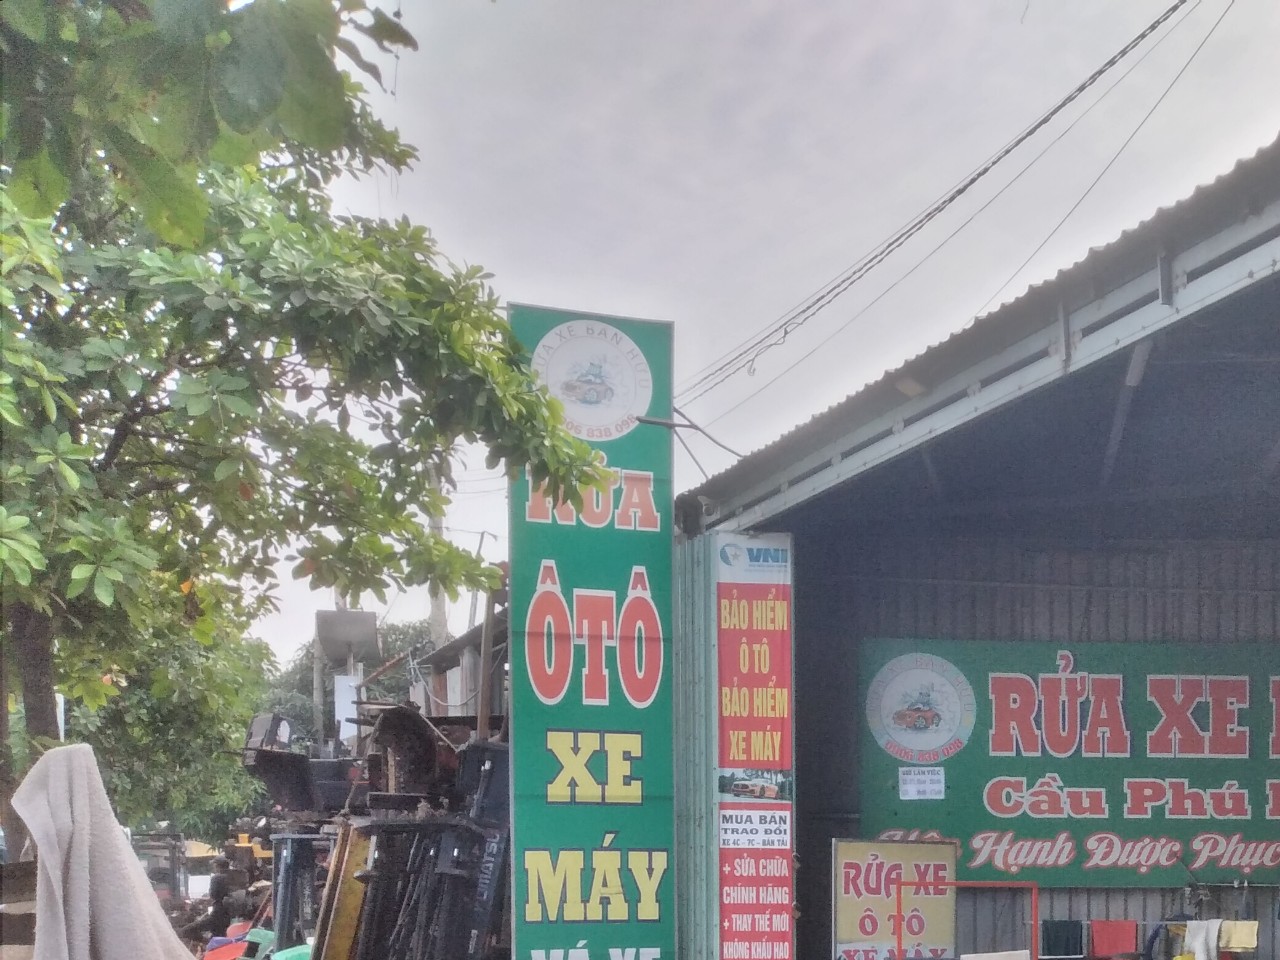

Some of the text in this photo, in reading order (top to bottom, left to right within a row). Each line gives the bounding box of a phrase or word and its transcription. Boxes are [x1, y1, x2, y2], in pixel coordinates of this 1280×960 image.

[721, 587, 788, 631] BẢO HIỂM
[739, 637, 770, 674] Ô TÔ
[721, 675, 788, 718] BẢO HIỂM
[989, 650, 1130, 758] RỬA
[1147, 674, 1249, 758] XE
[729, 725, 781, 761] XE MÁY
[546, 730, 643, 807] XE
[983, 773, 1108, 819] Cầu
[1123, 778, 1250, 820] Phú
[721, 812, 787, 825] MUA BÁN
[721, 827, 759, 835] TRAO
[734, 852, 756, 877] SỬA
[759, 854, 789, 877] CHỮA
[969, 830, 1076, 872] Hạnh
[1084, 830, 1184, 873] Được
[524, 831, 667, 923] MÁY
[723, 882, 756, 904] CHÍNH
[843, 853, 948, 900] RỬA XE
[732, 913, 752, 932] THAY
[754, 909, 770, 932] THẾ
[772, 911, 789, 932] MỚI
[858, 907, 879, 936] Ô
[723, 938, 750, 960] KHÔNG
[774, 941, 789, 960] HAO
